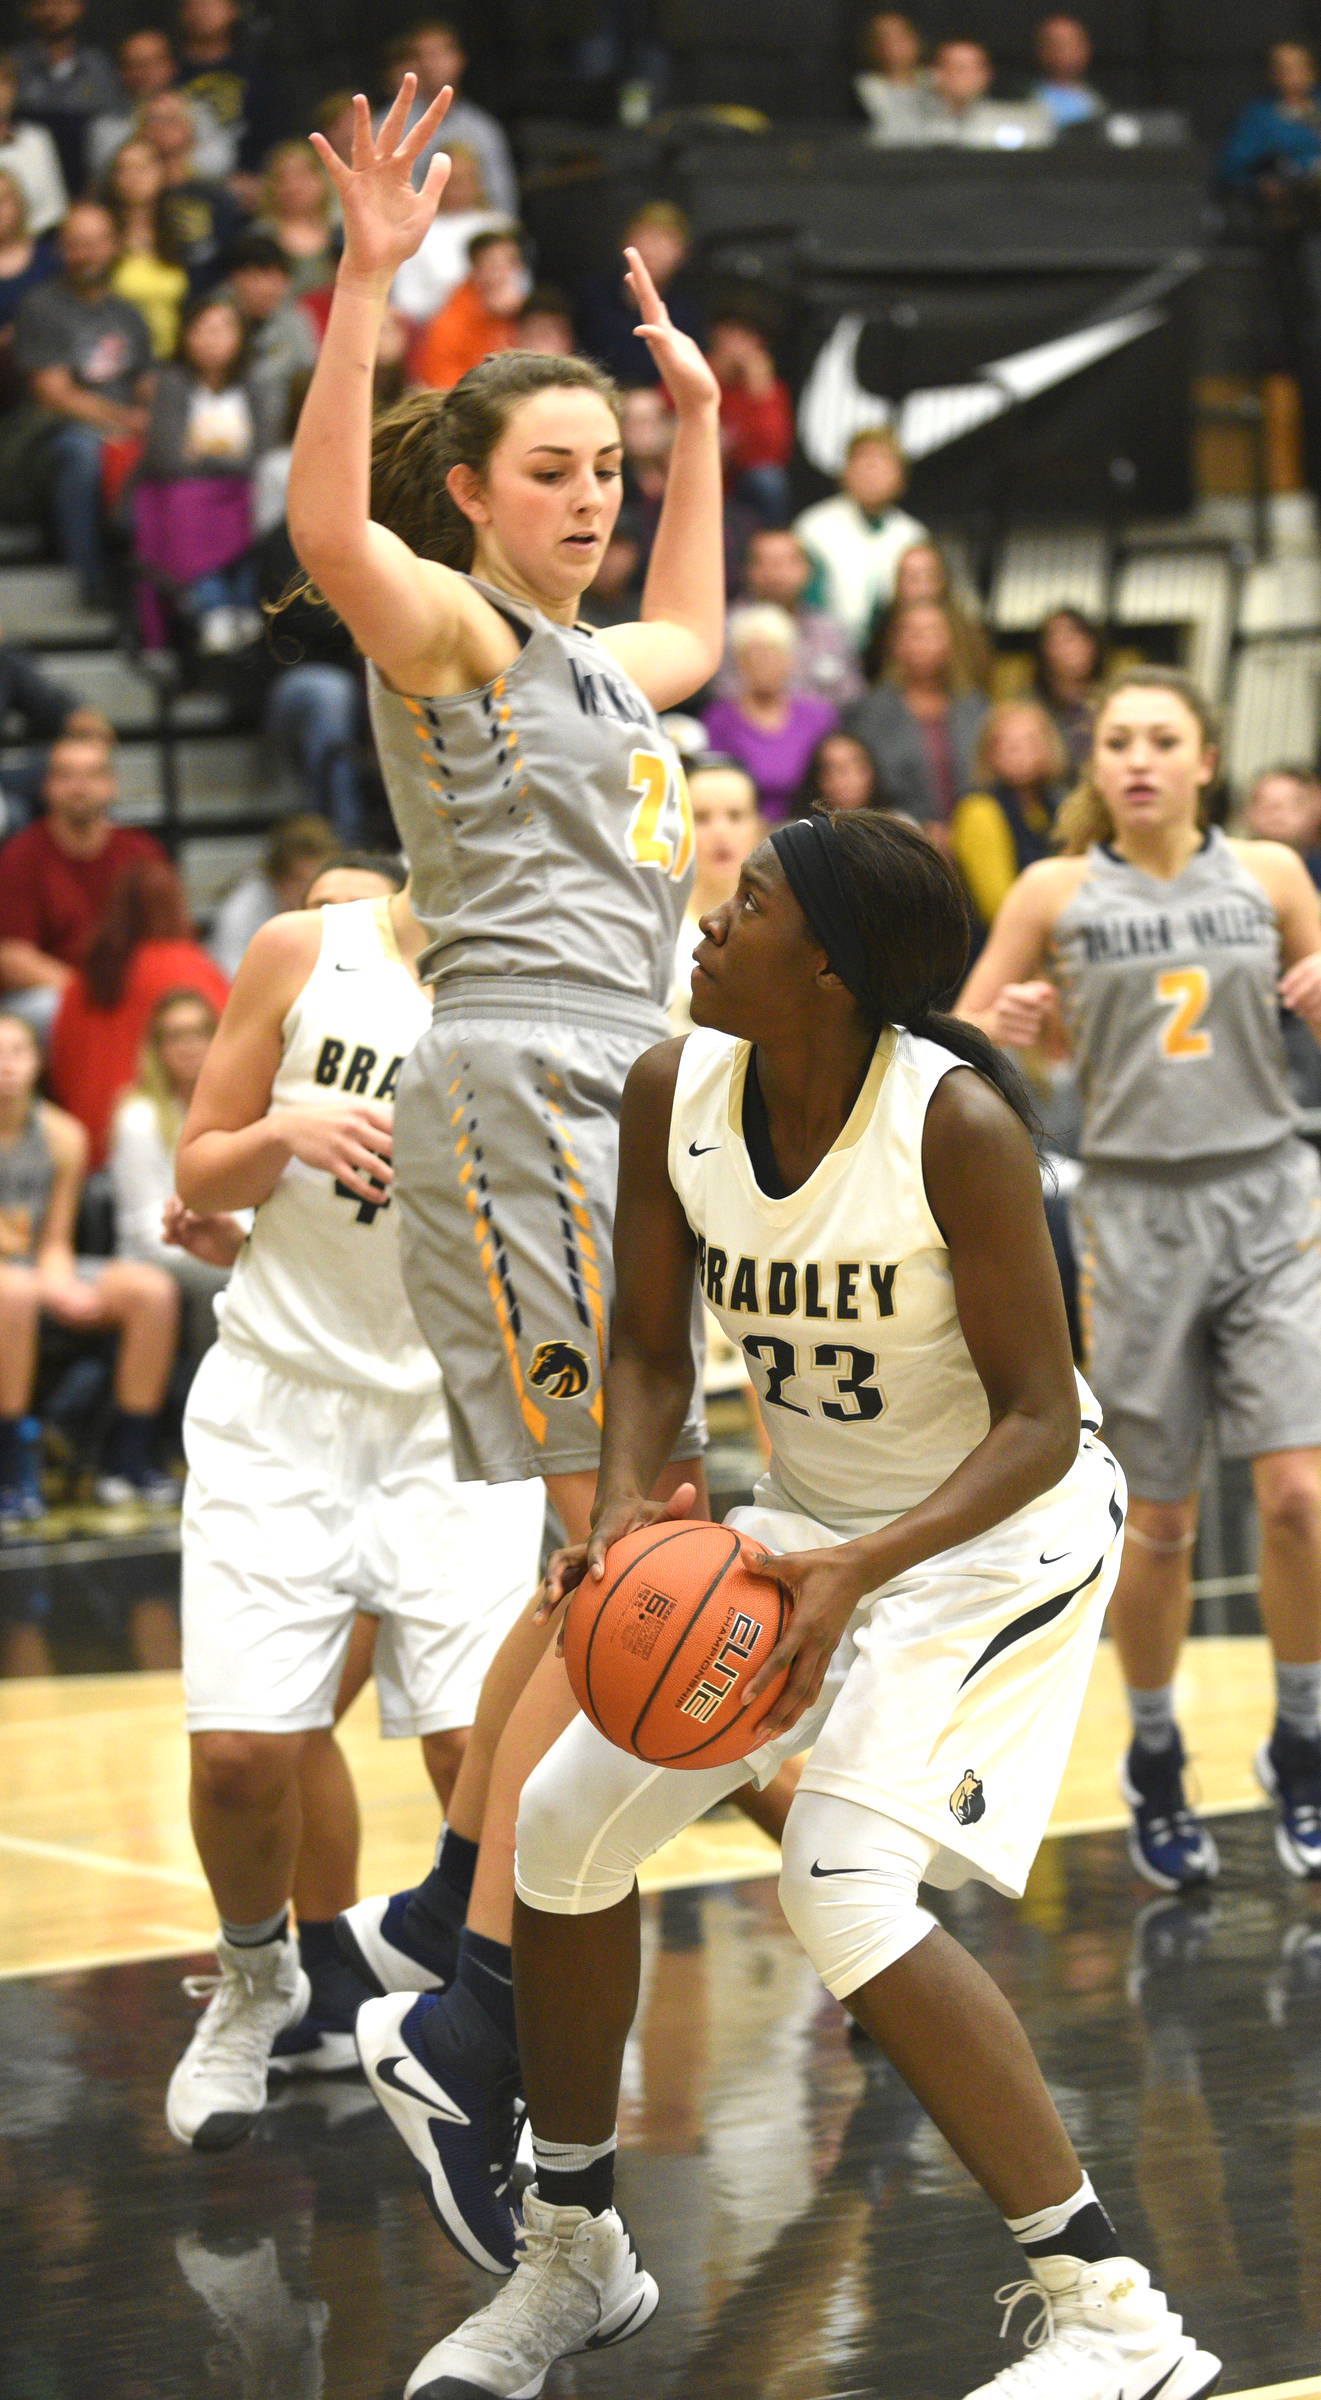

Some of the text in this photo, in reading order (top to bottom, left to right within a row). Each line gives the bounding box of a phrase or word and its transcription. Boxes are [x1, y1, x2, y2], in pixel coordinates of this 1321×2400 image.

[1156, 967, 1213, 1062] 2
[697, 1231, 903, 1322] BRADLEY
[738, 1332, 889, 1425] 23
[645, 1593, 670, 1618] 6
[674, 1606, 736, 1709] CHAMPIONSHIP
[680, 1611, 763, 1724] ELITE
